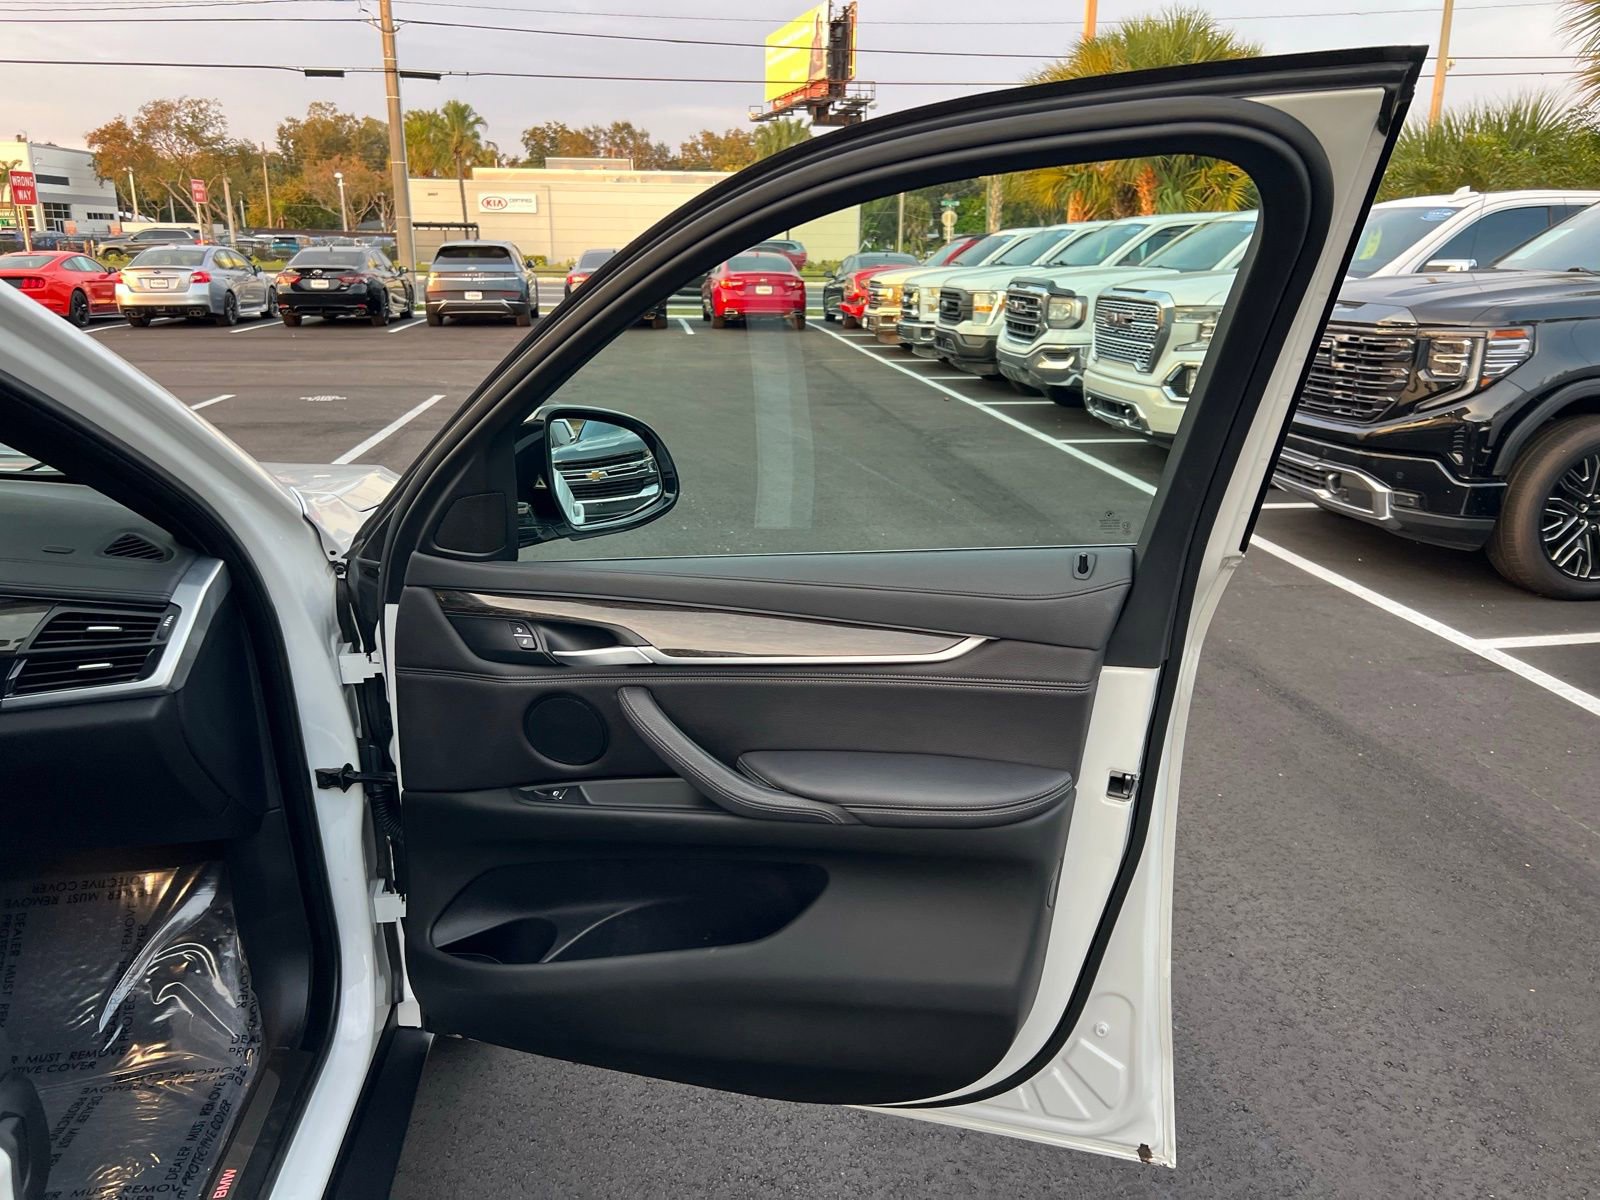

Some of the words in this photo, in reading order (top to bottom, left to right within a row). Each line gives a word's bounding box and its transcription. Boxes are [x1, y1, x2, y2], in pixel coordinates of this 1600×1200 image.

[11, 175, 34, 187] WRONG
[17, 190, 32, 200] WAY
[32, 880, 78, 894] COVER
[66, 891, 99, 904] MUST
[2, 964, 16, 995] MUST
[25, 1053, 63, 1064] MUST
[69, 1045, 126, 1061] REMOVE
[47, 1061, 97, 1073] COVER
[165, 1146, 193, 1181] DEALER
[186, 1120, 206, 1142] MUST
[200, 1074, 226, 1117] REMOVE
[182, 1128, 217, 1187] PROTECTIVE
[211, 1099, 232, 1130] COVER
[213, 1168, 238, 1199] BMW
